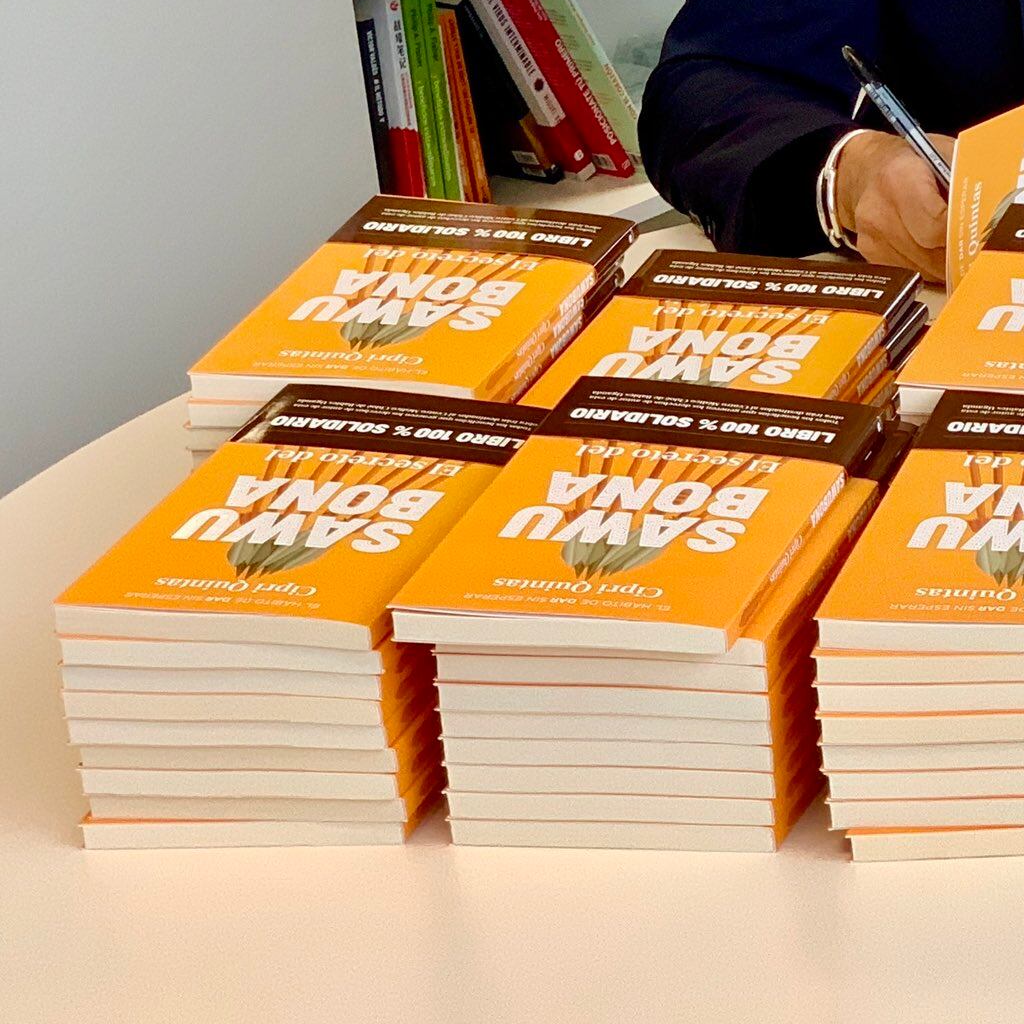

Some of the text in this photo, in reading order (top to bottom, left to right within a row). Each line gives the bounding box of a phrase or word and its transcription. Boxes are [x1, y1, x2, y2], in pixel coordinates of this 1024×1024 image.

[490, 3, 508, 27] VIRUS
[502, 25, 535, 76] INTERMINABLE
[968, 182, 982, 256] Quintas
[332, 269, 527, 306] BONA
[288, 296, 503, 331] SAWU
[627, 326, 821, 359] BONA
[588, 351, 801, 385] SAWU
[271, 415, 525, 449] LIBRO 100 % SOLIDARIO
[570, 407, 836, 443] LIBRO 100 % SOLIDARIO
[225, 474, 445, 521] BONA
[545, 470, 769, 520] BONA
[171, 508, 413, 553] SAWU
[498, 505, 746, 553] SAWU
[494, 578, 664, 598] Cipri Quintas
